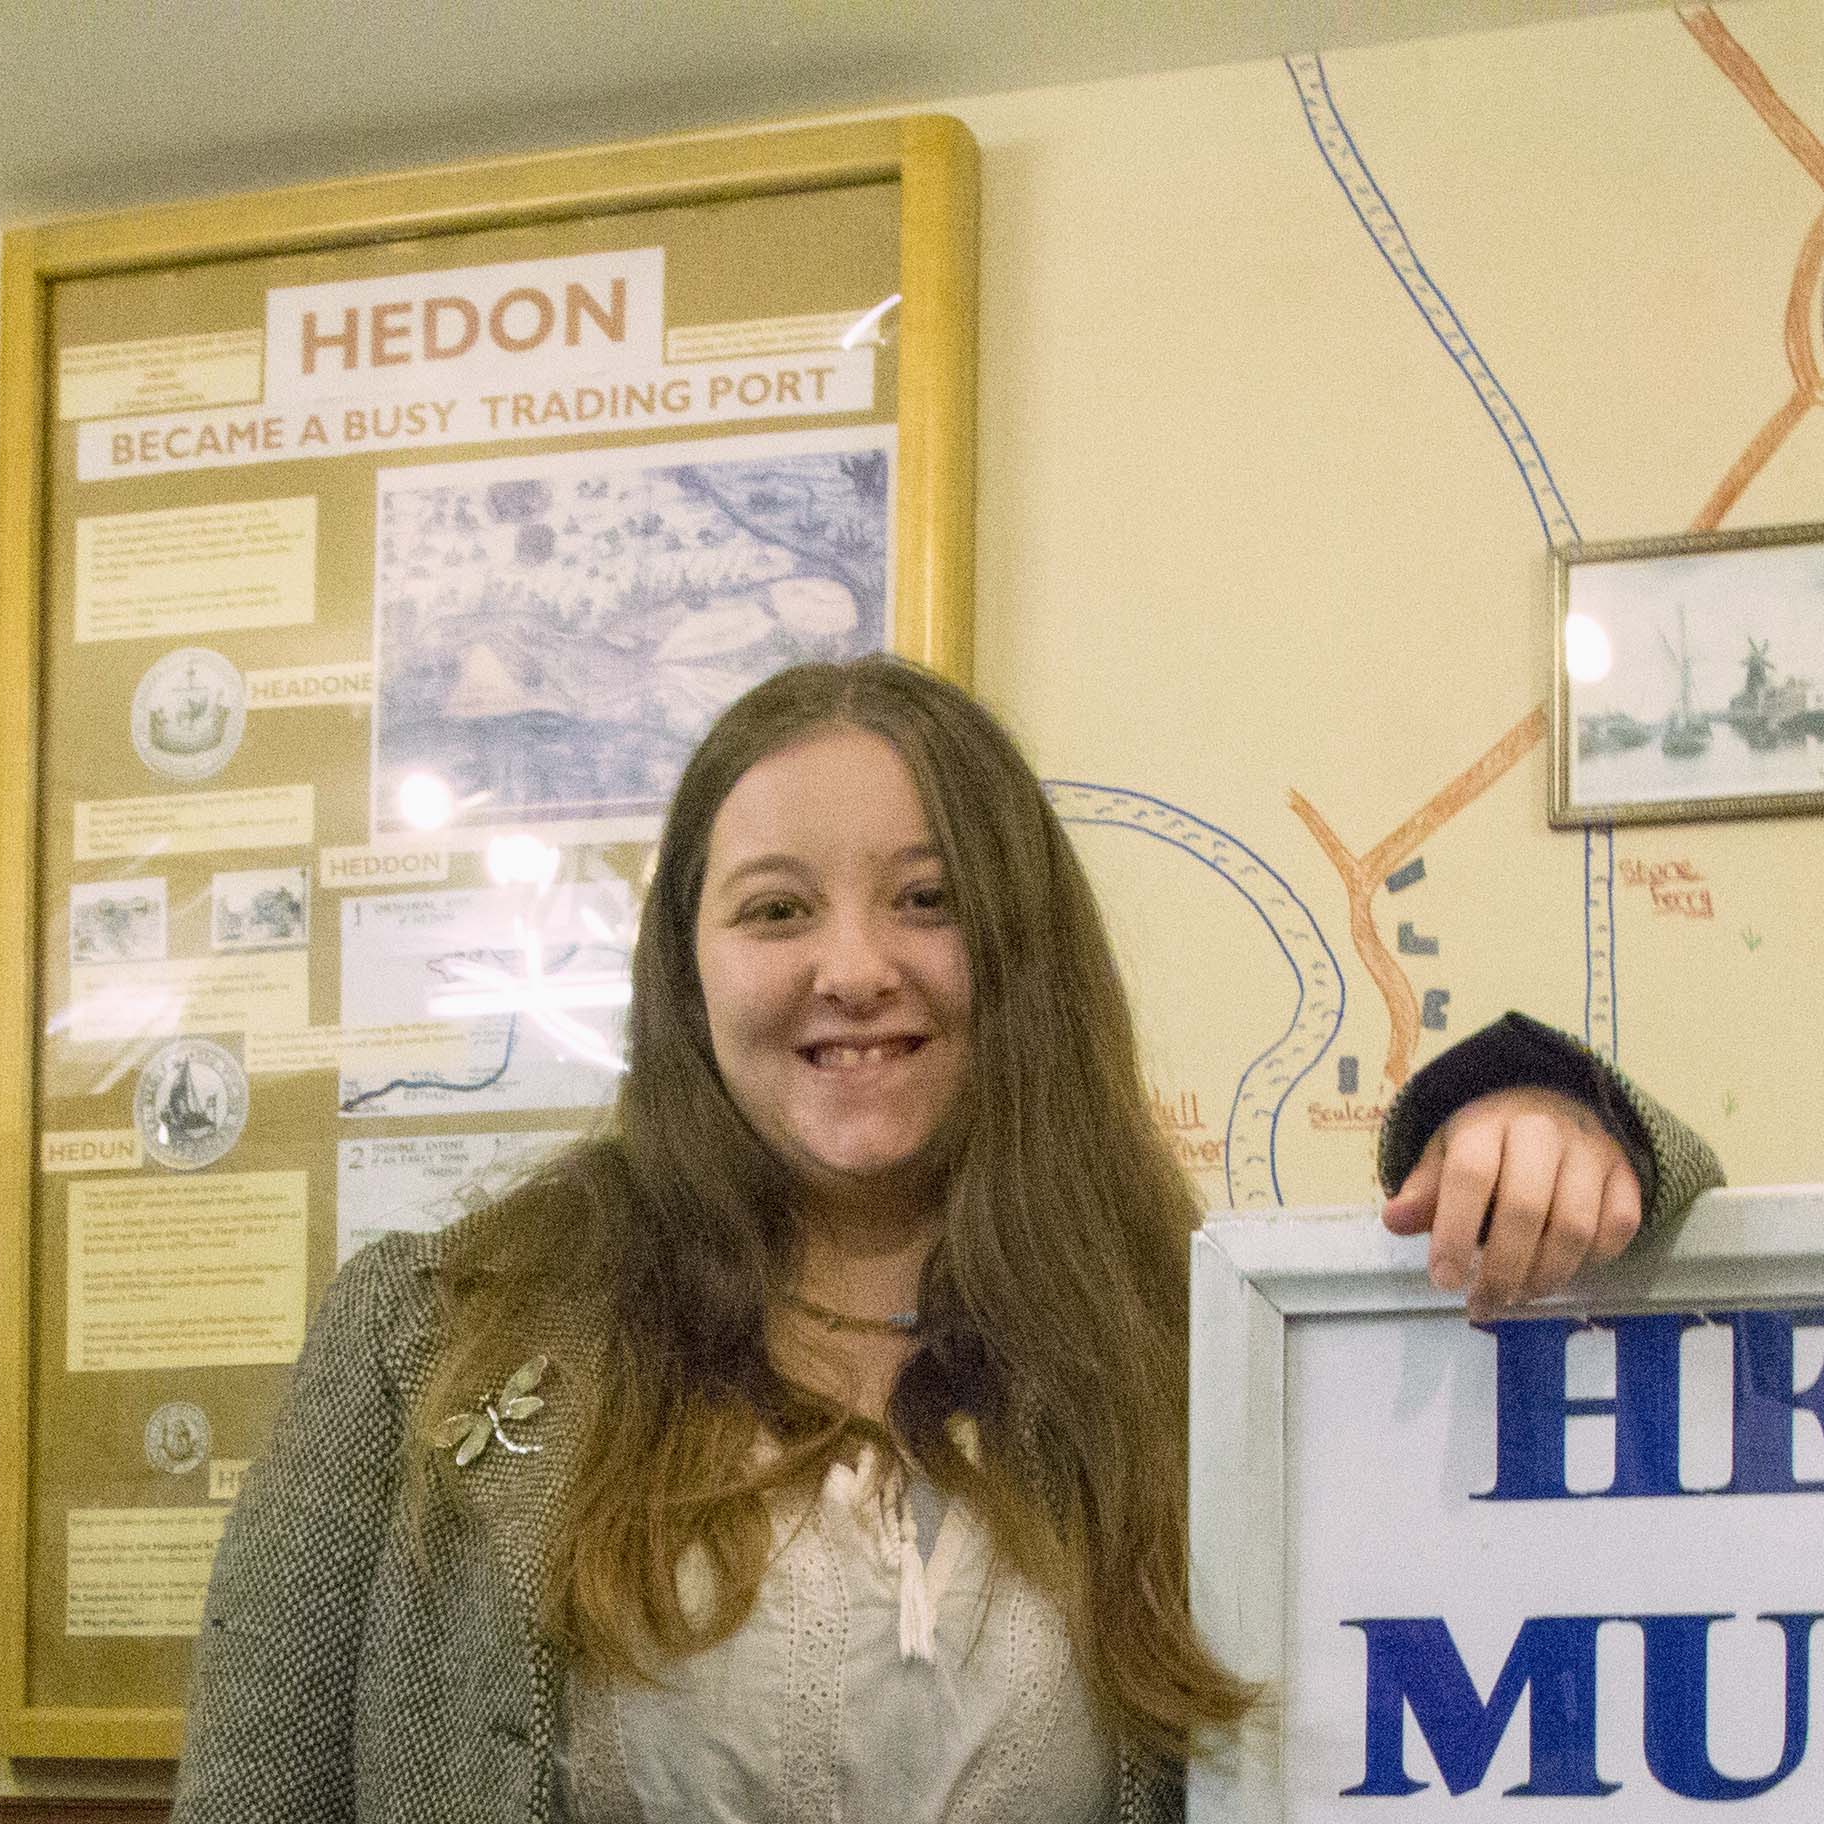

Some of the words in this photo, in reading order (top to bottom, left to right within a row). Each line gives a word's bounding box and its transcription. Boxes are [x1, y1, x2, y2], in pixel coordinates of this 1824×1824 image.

[300, 276, 629, 376] HEDON
[110, 415, 284, 466] BECAME
[297, 414, 329, 446] A
[343, 398, 459, 443] BUSY
[480, 377, 691, 429] TRADING
[708, 364, 837, 409] PORT
[328, 852, 441, 877] HEDDON
[49, 1139, 134, 1161] HEDUN
